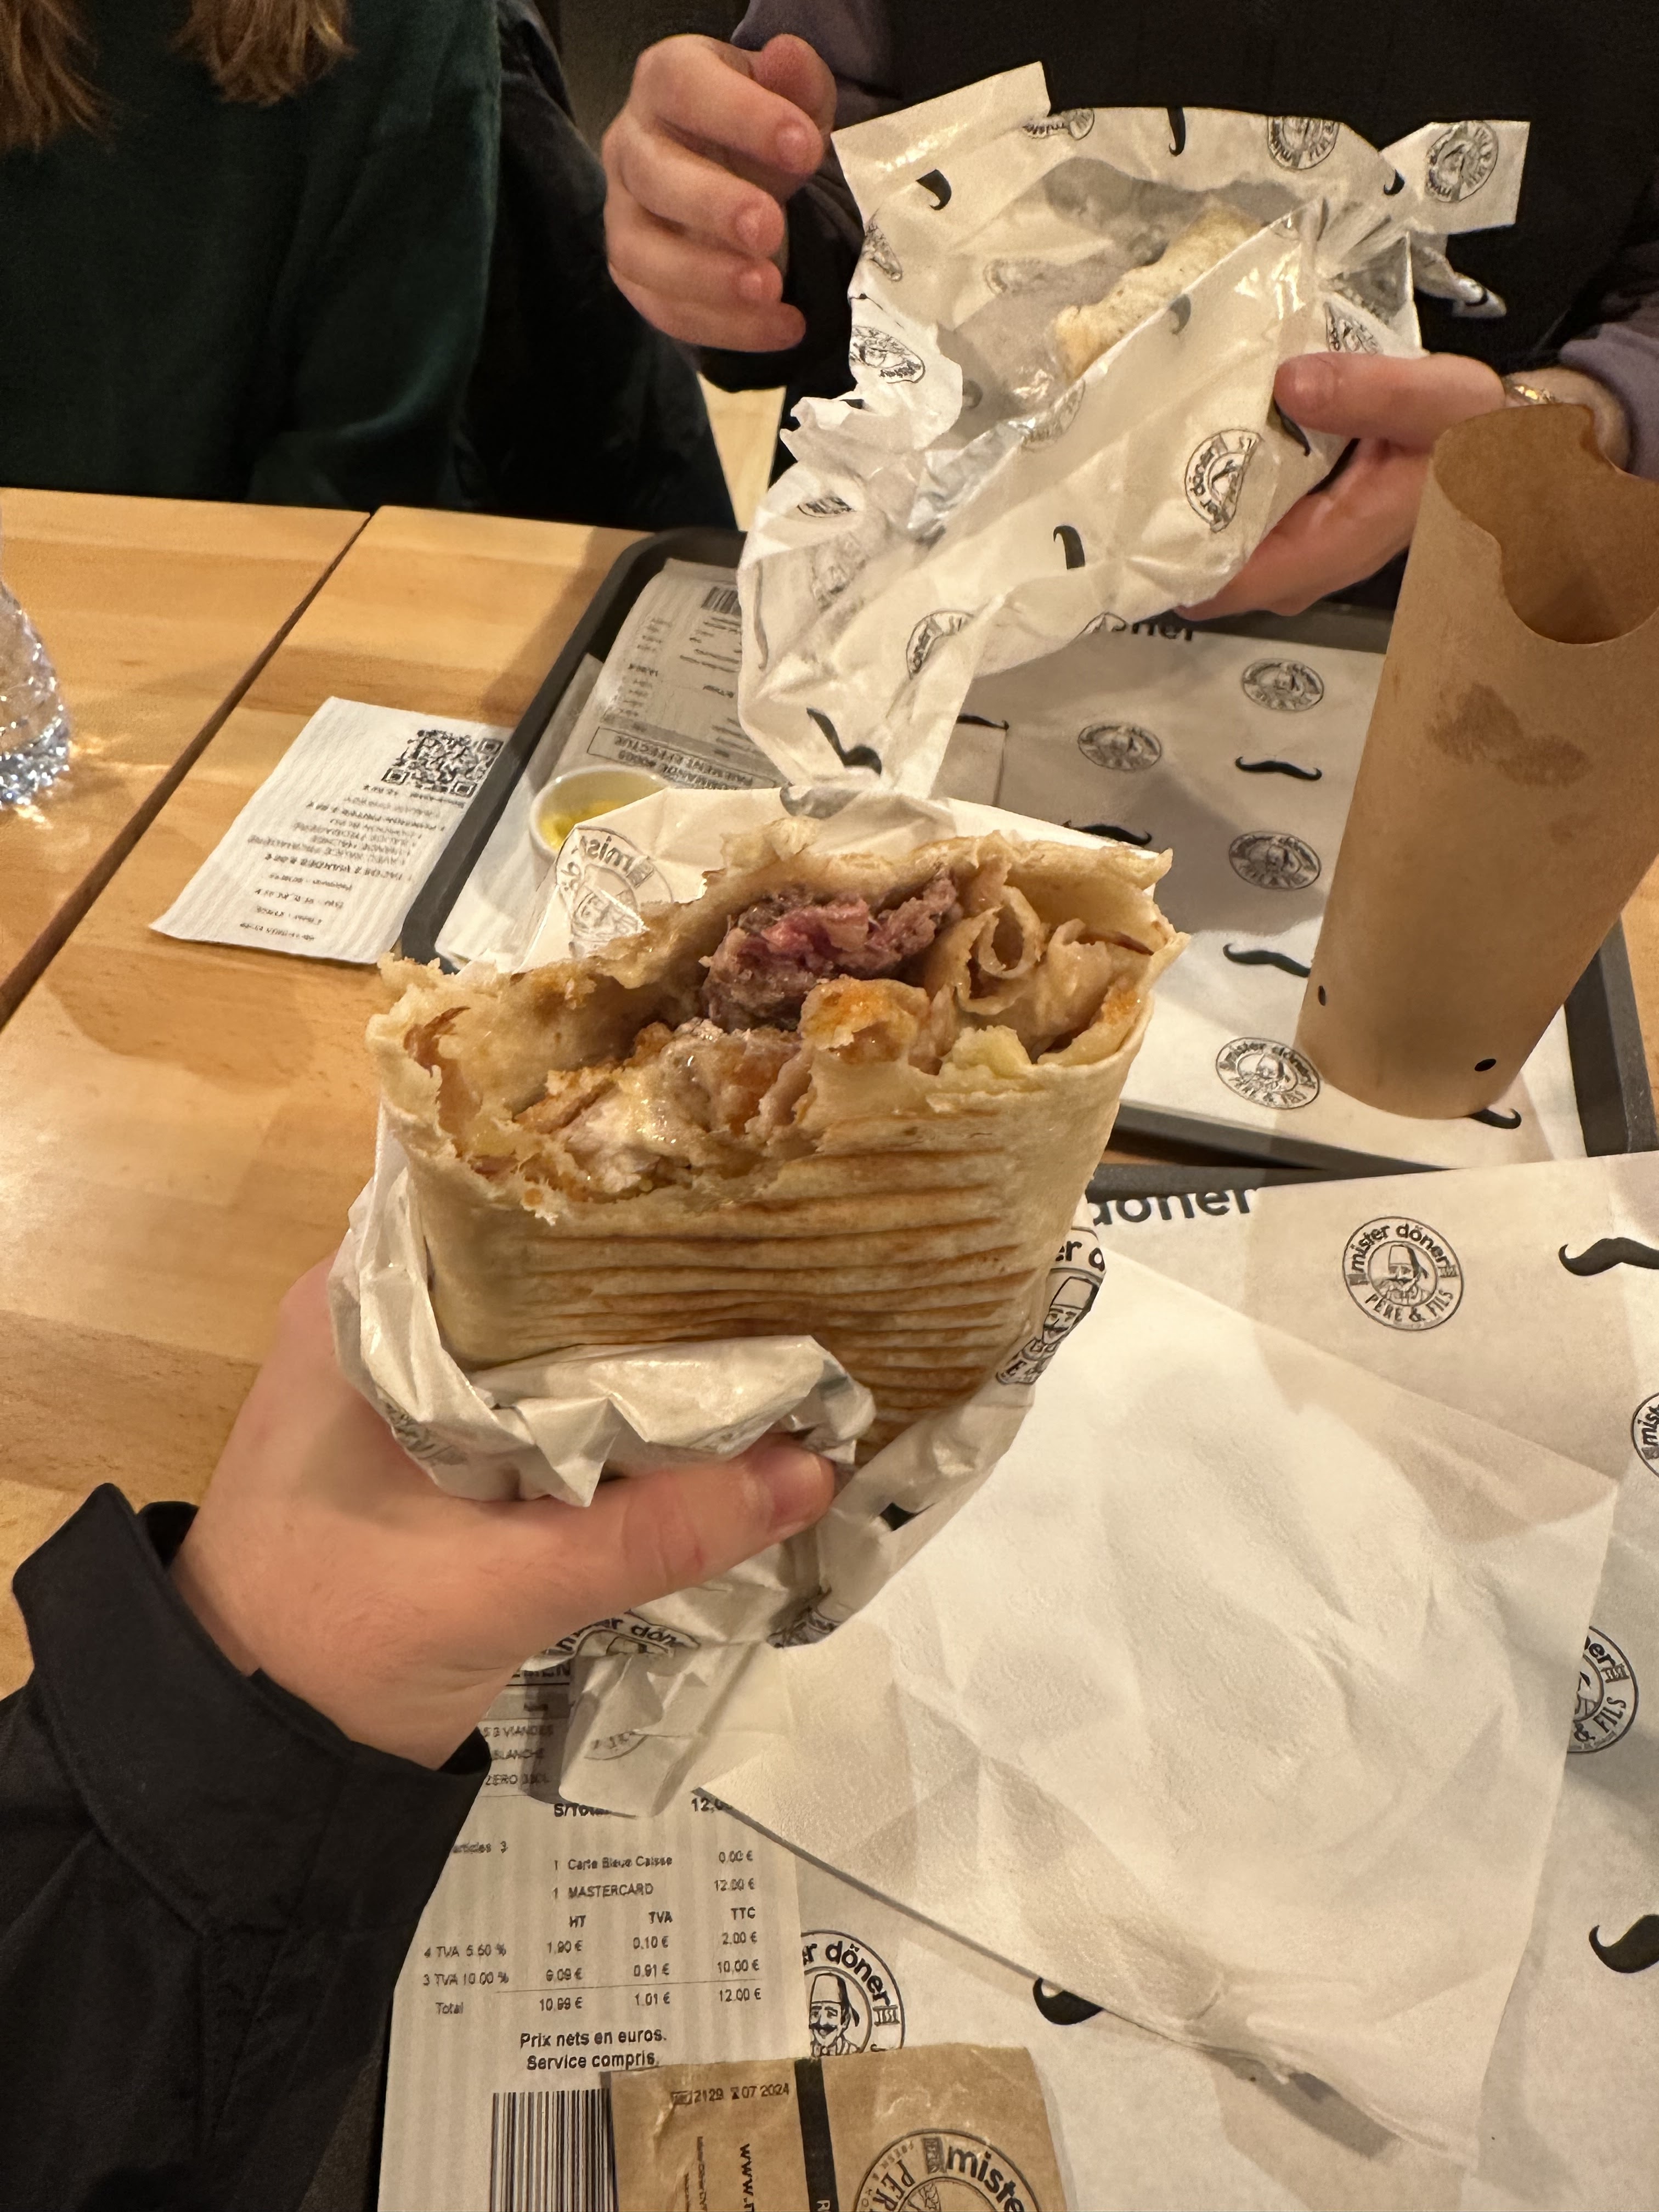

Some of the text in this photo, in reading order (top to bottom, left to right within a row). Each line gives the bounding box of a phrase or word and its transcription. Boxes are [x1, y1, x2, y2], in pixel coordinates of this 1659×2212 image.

[1351, 1223, 1450, 1273] mister döner
[1409, 1306, 1426, 1322] &
[1426, 1290, 1454, 1317] FILS
[1637, 1403, 1659, 1446] mist
[1573, 1696, 1627, 1742] & FILS
[486, 1774, 518, 1786] ZERO
[500, 1841, 508, 1853] 3
[746, 1850, 754, 1861] €
[568, 1882, 654, 1899] MASTERCARD
[714, 1878, 745, 1891] 12.00
[747, 1877, 755, 1889] €
[568, 1906, 756, 1928] HT TVA TTC
[436, 1946, 460, 1957] TVA
[574, 1940, 583, 1952] €
[633, 1936, 658, 1949] 0.10
[662, 1936, 669, 1948] €
[721, 1931, 747, 1945] 2.00
[749, 1931, 758, 1944] €
[434, 1973, 458, 1985] TVA
[574, 1968, 583, 1980] €
[662, 1963, 670, 1976] €
[752, 1959, 760, 1971] €
[825, 1940, 891, 2006] döner
[436, 2002, 464, 2015] Total
[574, 1997, 583, 2009] €
[634, 1993, 658, 2006] 1.01
[663, 1991, 670, 2005] €
[719, 1988, 750, 2002] 12.00
[754, 1988, 761, 2000] €
[521, 2029, 667, 2049] Prix nets en euros.
[527, 2055, 586, 2070] Service
[946, 2146, 1025, 2212] miste
